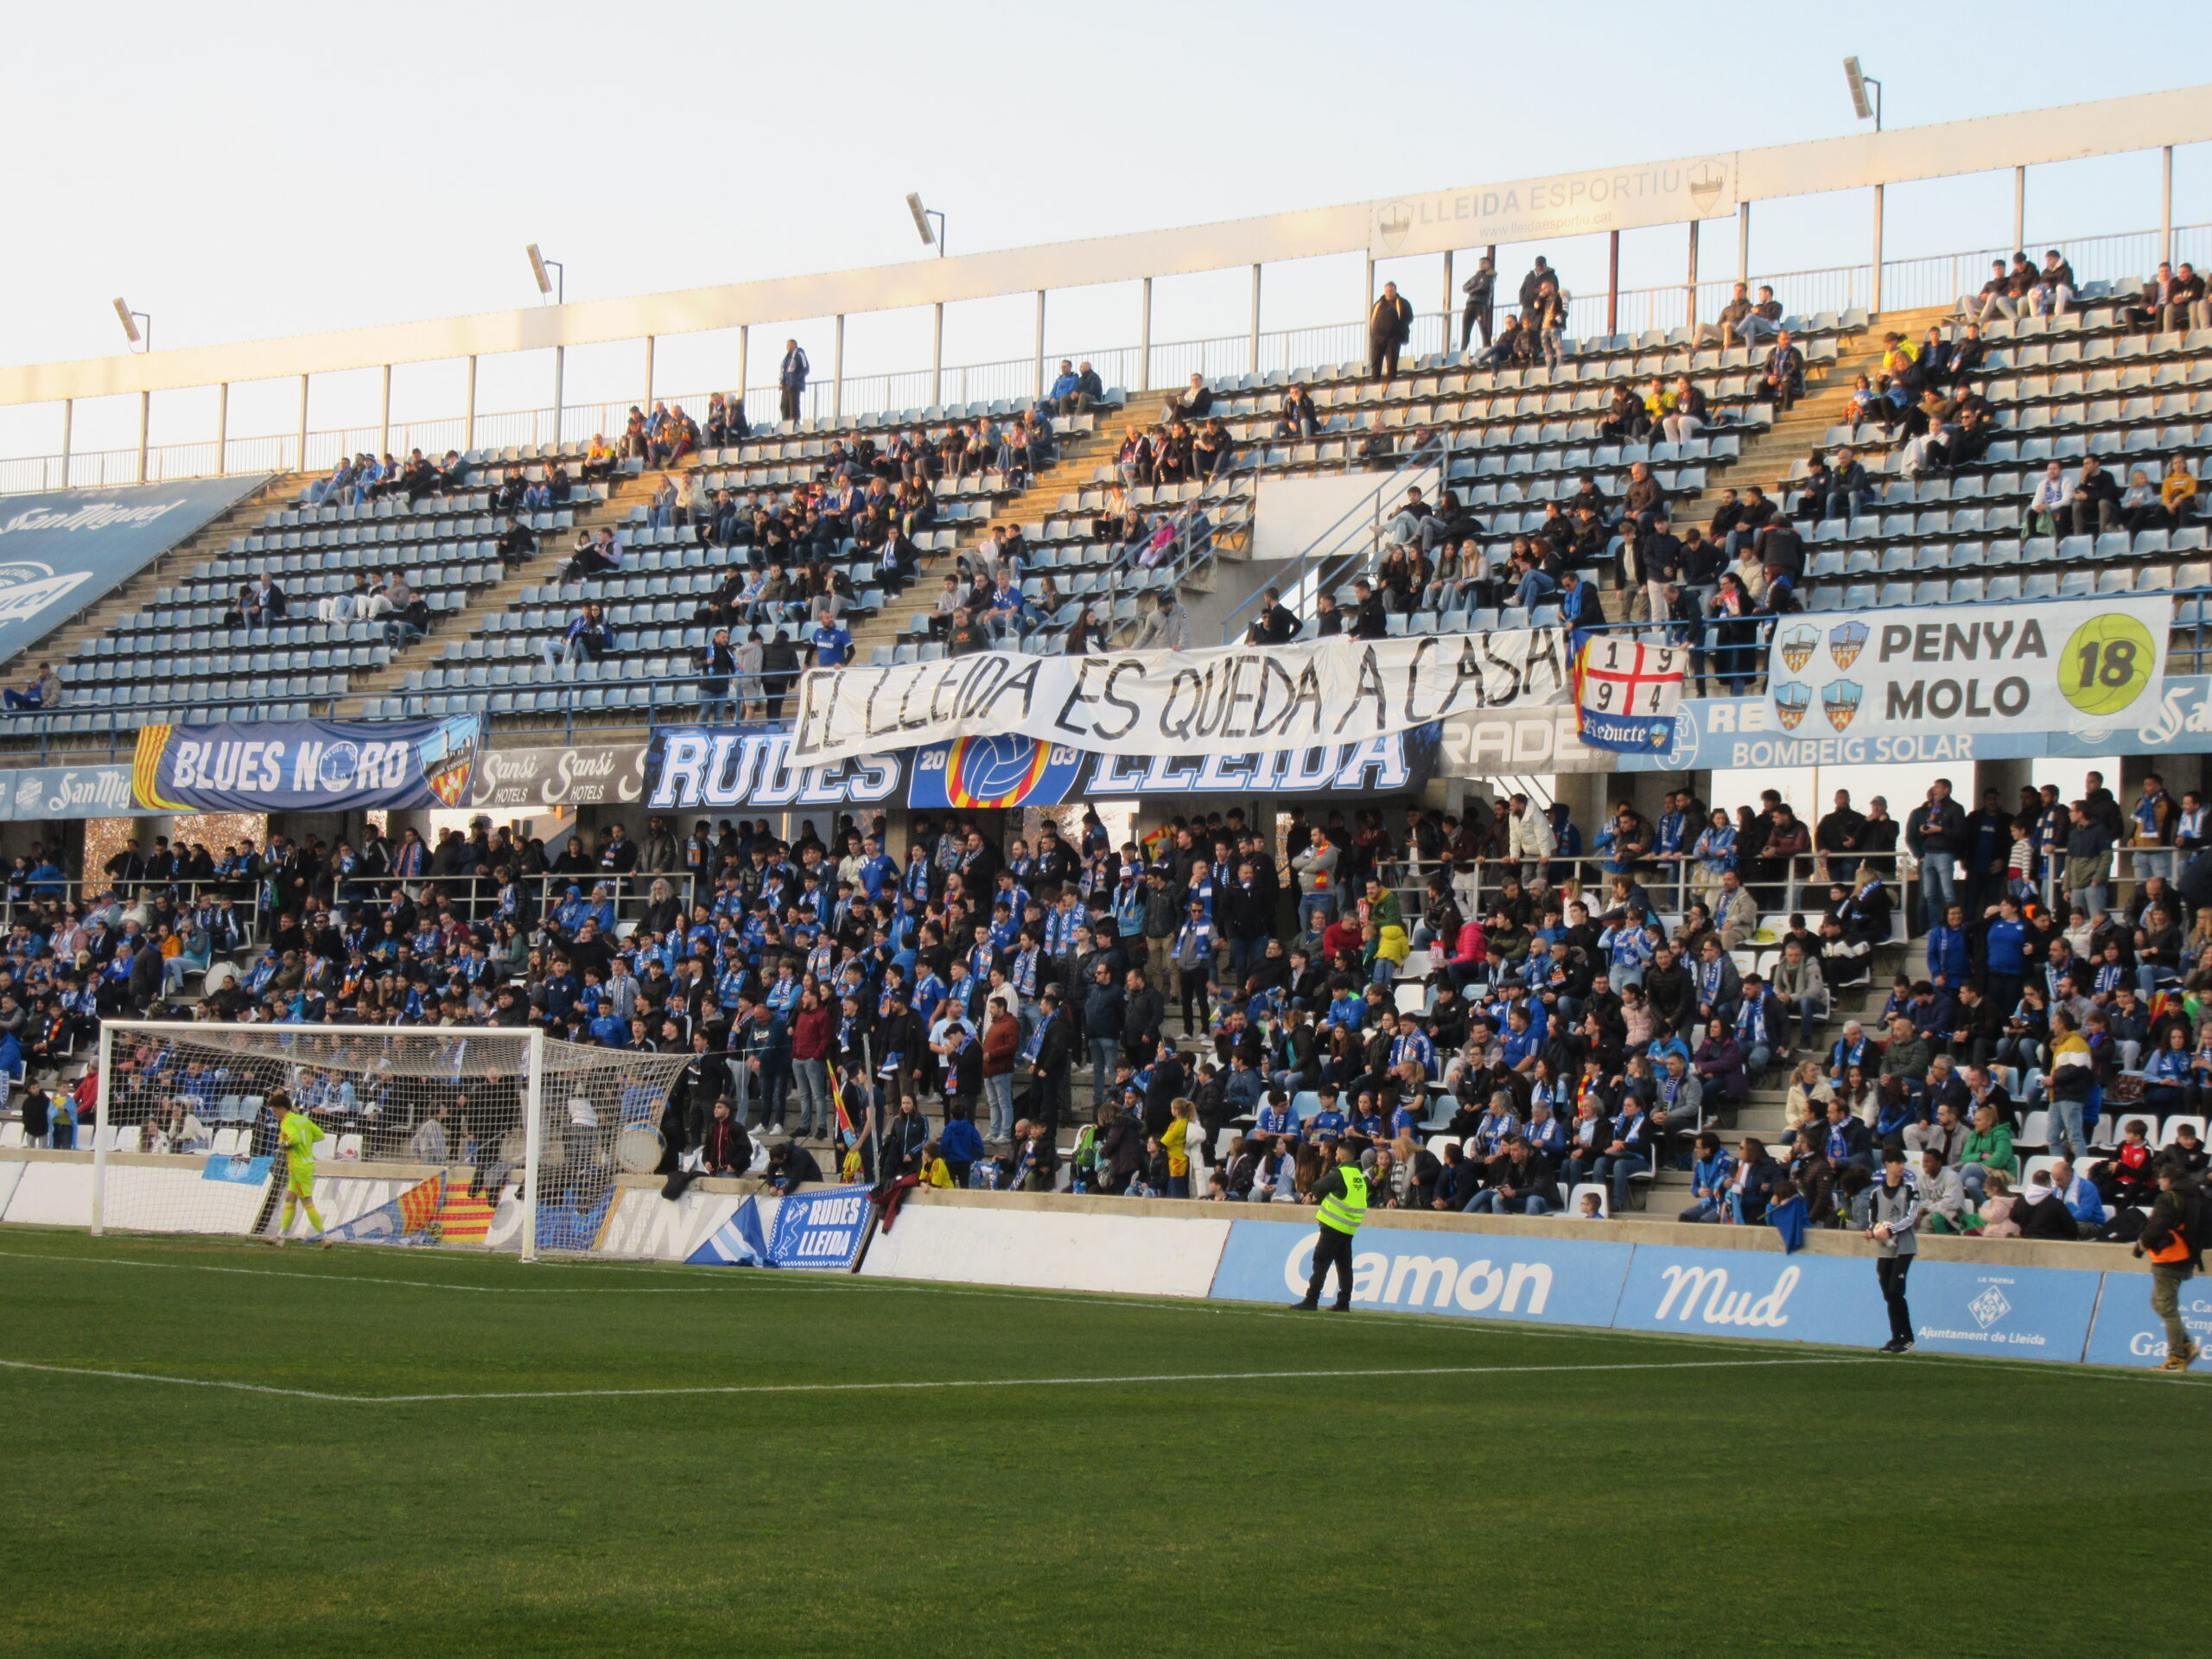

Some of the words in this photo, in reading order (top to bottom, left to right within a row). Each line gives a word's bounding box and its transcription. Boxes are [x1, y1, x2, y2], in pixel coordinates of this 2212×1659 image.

[1420, 189, 1521, 226] LLEIDA
[1529, 168, 1681, 211] ESPORTIU
[1479, 212, 1612, 238] www.lleidaesportiu.cat
[1605, 641, 1618, 669] 1
[1657, 648, 1673, 672] 9
[1878, 618, 2049, 664] PENYA
[2078, 639, 2137, 689] 18
[796, 670, 846, 756] EL
[866, 655, 1042, 740] LLEIDA
[1054, 658, 1147, 741] ES
[1159, 655, 1321, 742] QUEDA
[1334, 644, 1386, 735] A
[1405, 626, 1562, 724] CASA
[1596, 683, 1612, 710] 9
[1649, 684, 1662, 713] 4
[1885, 677, 2030, 721] MOLO
[1583, 714, 1646, 742] Reducte
[921, 751, 944, 770] 20
[1051, 748, 1075, 766] 03
[1732, 735, 1866, 767] BOMBEIG
[1875, 733, 1974, 762] SOLAR
[174, 740, 284, 793] BLUES
[473, 752, 539, 804] Sansi
[541, 750, 615, 804] Sansi
[494, 787, 528, 802] HOTELS
[570, 785, 604, 801] HOTELS
[807, 1197, 861, 1226] RUDES
[797, 1230, 852, 1257] LLEIDA
[1655, 1263, 1802, 1328] Mud
[1918, 1326, 1988, 1341] Ajuntament
[1991, 1332, 2006, 1343] de
[2008, 1332, 2046, 1345] Lleida
